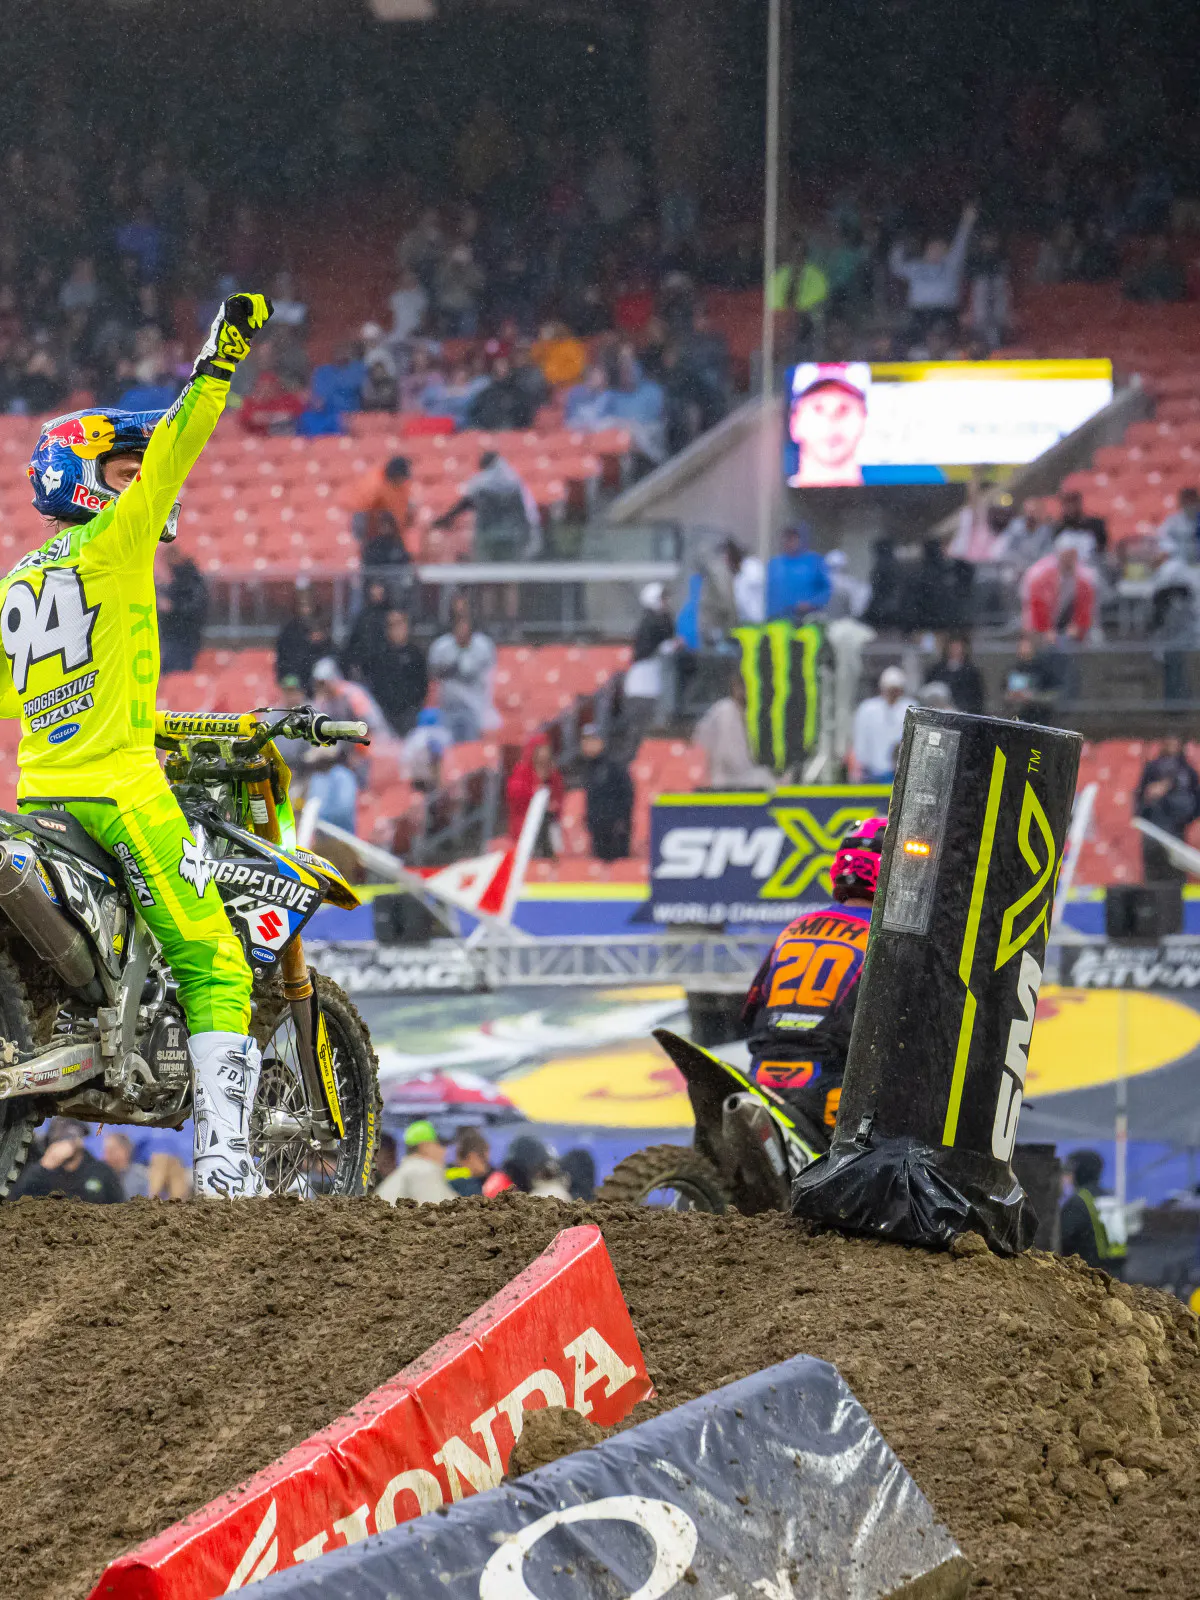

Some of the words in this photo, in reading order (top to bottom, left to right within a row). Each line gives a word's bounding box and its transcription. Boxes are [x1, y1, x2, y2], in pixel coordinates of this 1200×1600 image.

[0, 565, 102, 695] 94
[24, 670, 99, 719] PROGRESSIVE
[129, 604, 155, 728] FOX
[31, 693, 94, 733] SUZUKI
[50, 729, 64, 742] CYCLE
[63, 725, 77, 737] GEAR
[165, 721, 240, 732] RENTHA
[113, 842, 156, 907] SUZUKI
[654, 807, 878, 899] SMX
[767, 942, 855, 1008] 20
[156, 1050, 188, 1061] SUZUKI
[217, 1065, 245, 1088] FOX
[362, 1112, 375, 1189] DUNLOP
